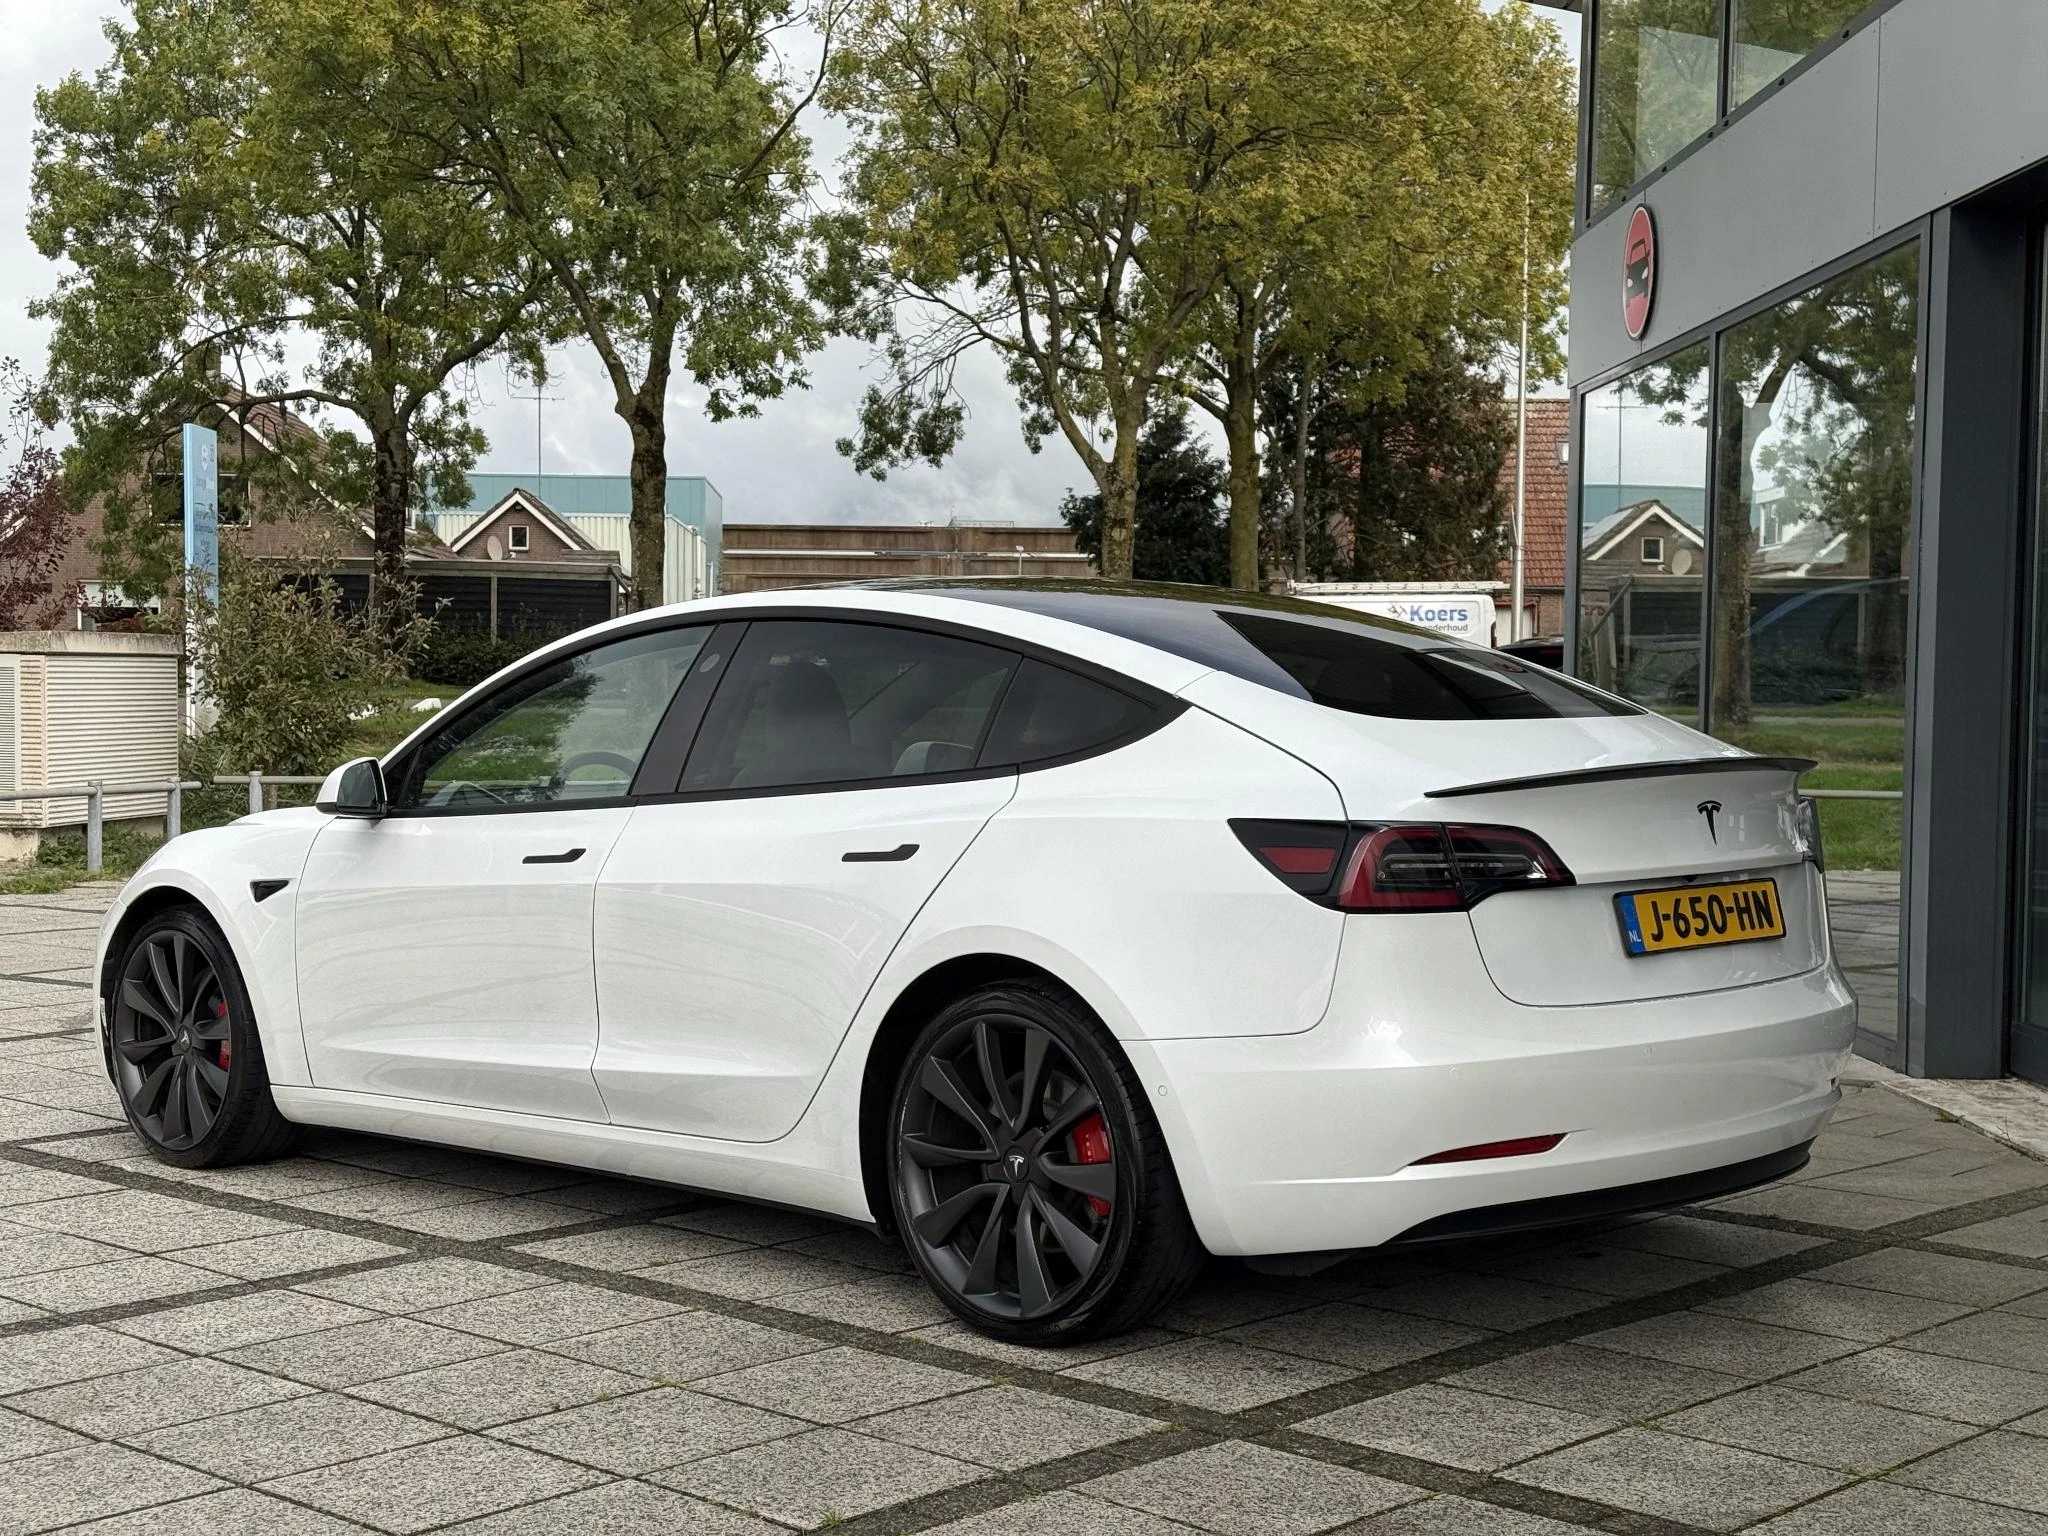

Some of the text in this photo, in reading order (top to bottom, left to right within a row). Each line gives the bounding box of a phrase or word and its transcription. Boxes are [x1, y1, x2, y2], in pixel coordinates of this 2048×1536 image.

[1410, 605, 1468, 621] Koers
[1424, 624, 1468, 632] nderhoud
[1651, 890, 1774, 942] J-650-HN
[1628, 930, 1641, 942] NL
